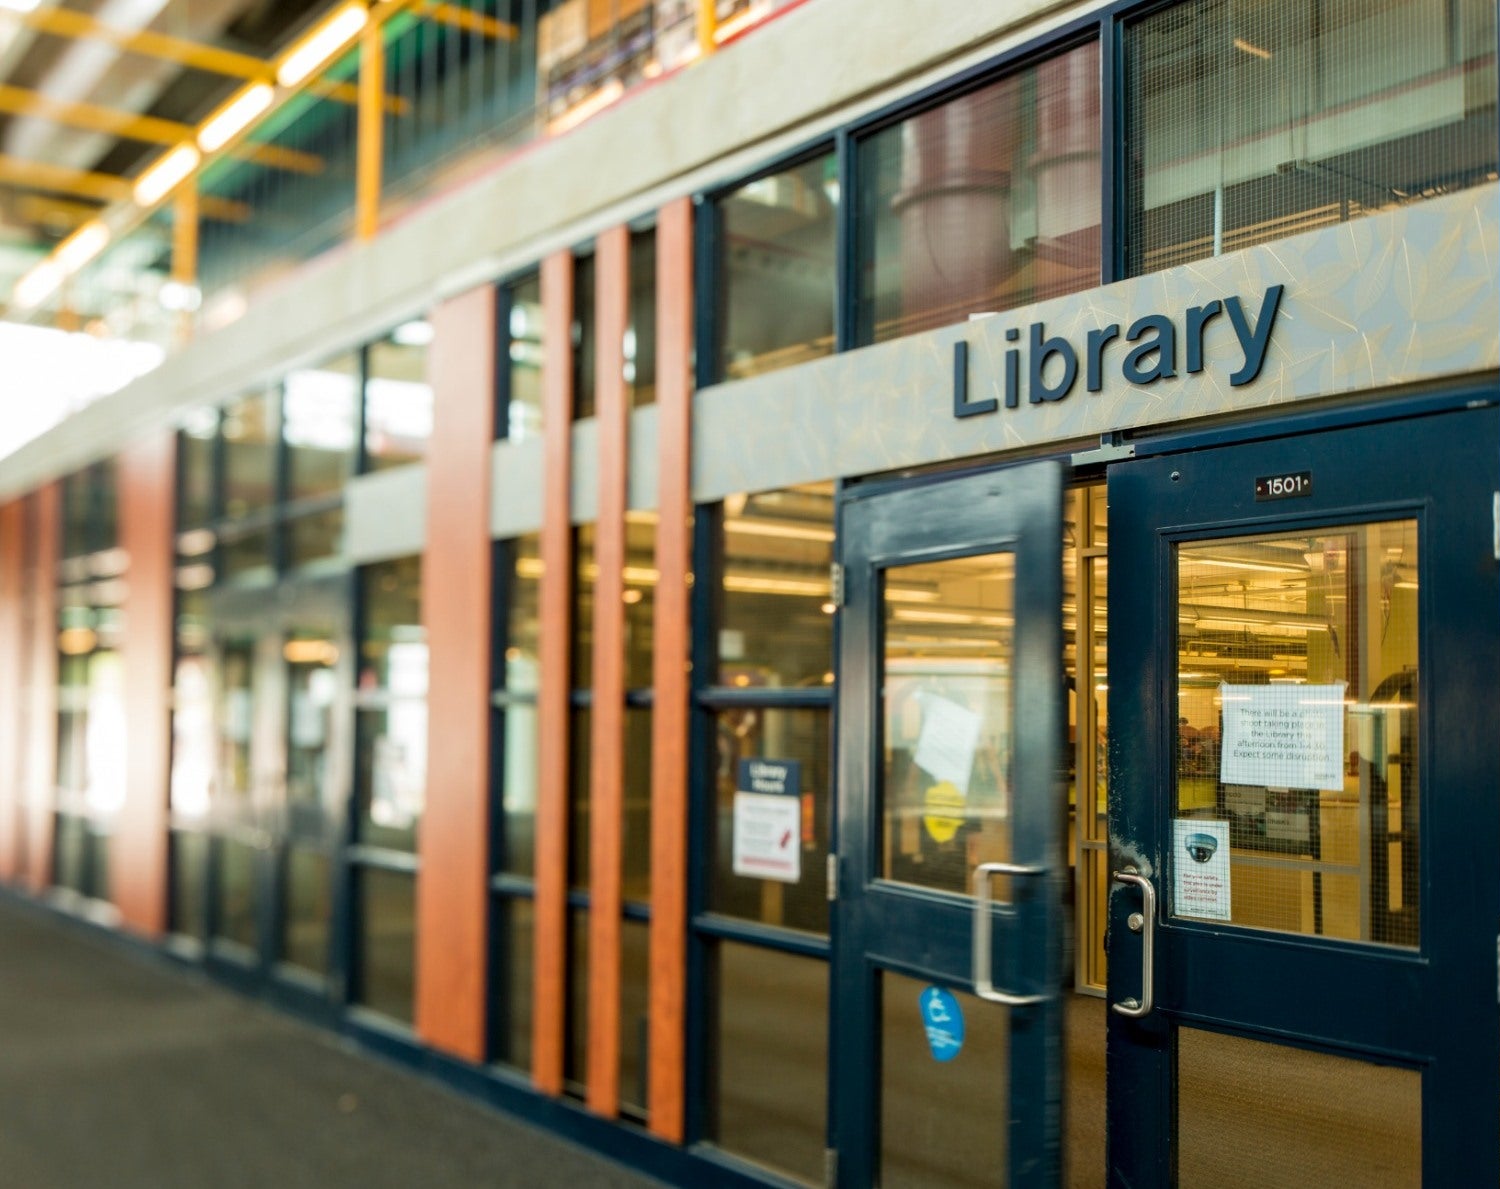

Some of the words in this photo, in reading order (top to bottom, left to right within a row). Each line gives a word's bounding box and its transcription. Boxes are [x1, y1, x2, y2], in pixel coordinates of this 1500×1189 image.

[954, 284, 1284, 419] Library
[1266, 476, 1302, 495] 1501
[1240, 708, 1262, 717] There
[1264, 708, 1278, 717] will
[1279, 709, 1290, 718] be
[1264, 720, 1290, 730] taking
[1251, 730, 1264, 738] the
[1266, 730, 1295, 740] Library
[1237, 739, 1276, 749] afternoon
[1277, 740, 1297, 749] from
[1233, 749, 1260, 760] Expect
[1262, 751, 1284, 761] some
